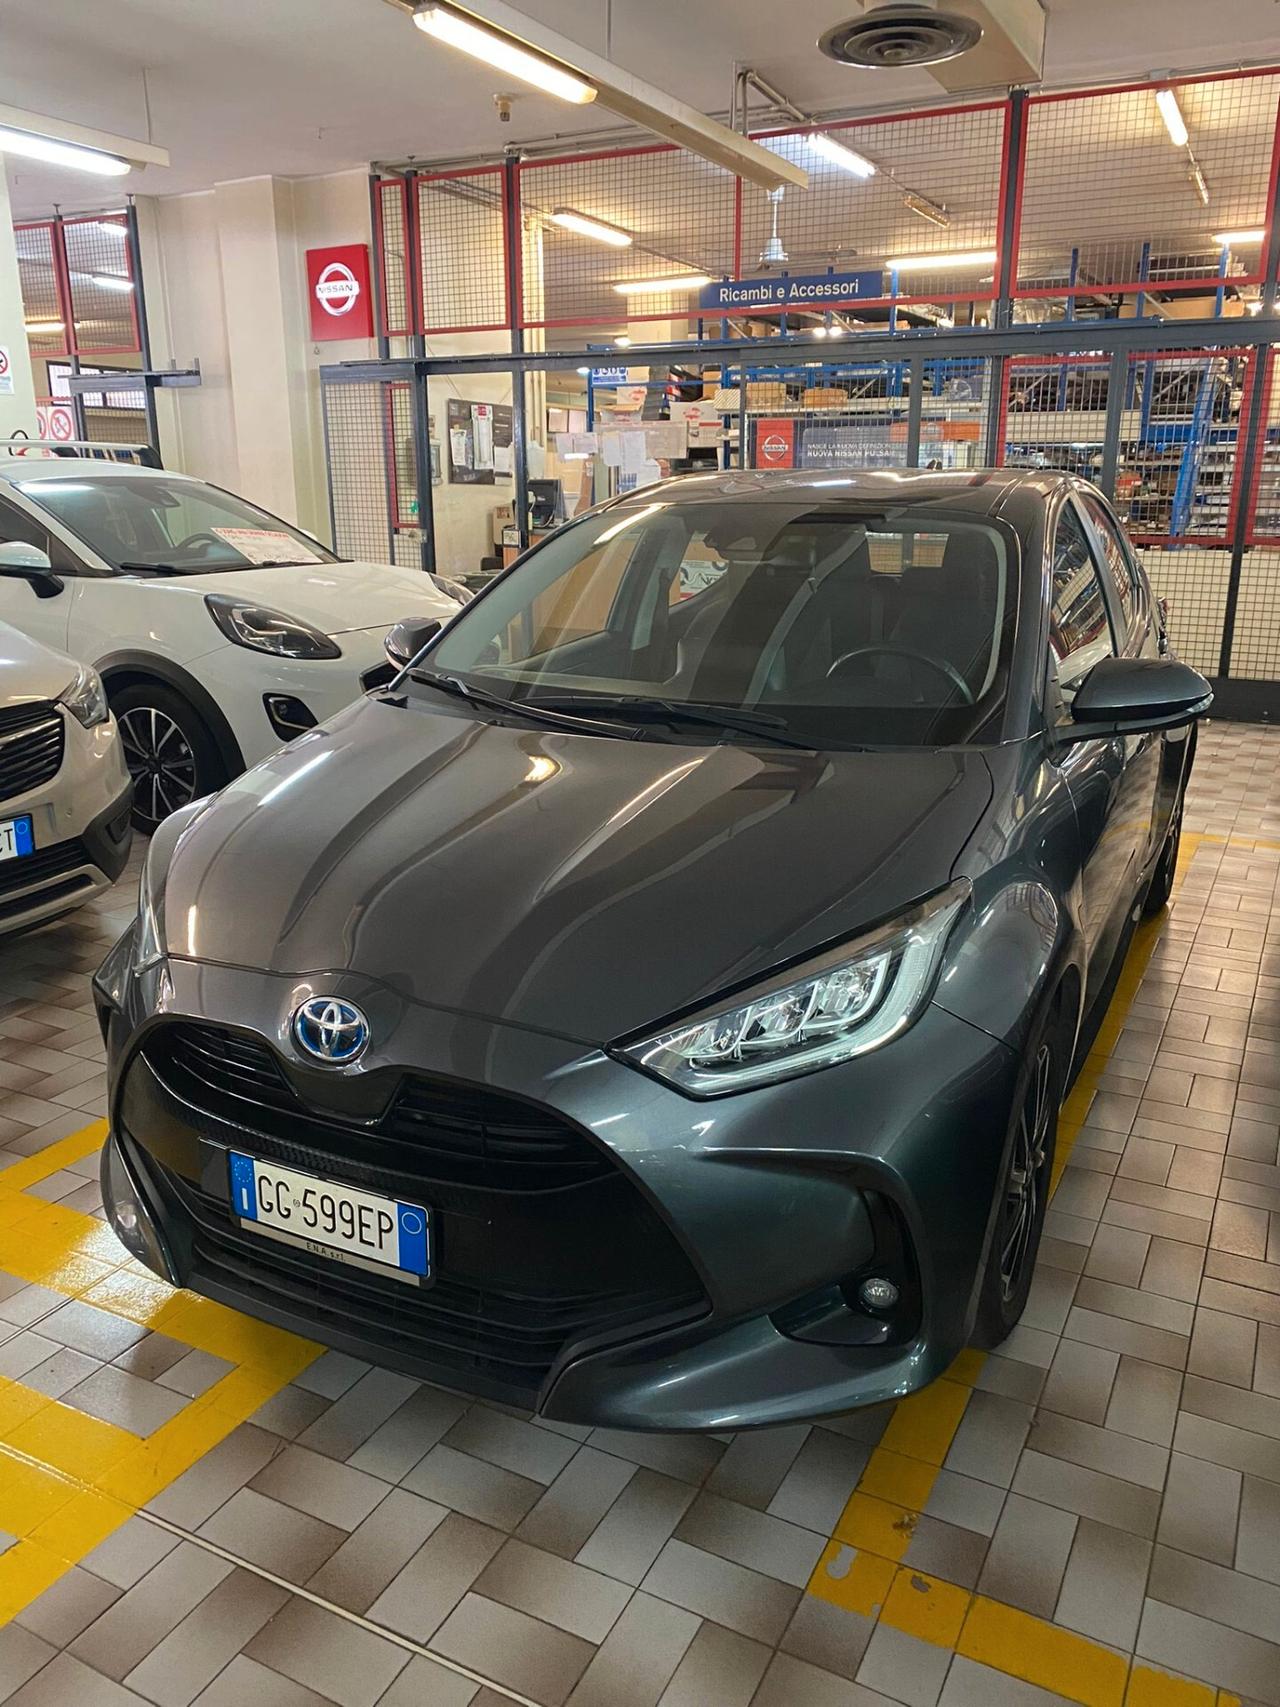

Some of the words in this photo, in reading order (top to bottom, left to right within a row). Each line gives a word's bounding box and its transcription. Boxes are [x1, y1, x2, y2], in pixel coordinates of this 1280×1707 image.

[318, 284, 353, 294] NISSAN
[720, 285, 772, 302] Ricambi
[777, 288, 785, 298] e
[789, 279, 859, 297] Accessori
[807, 449, 833, 457] NUOVA
[835, 449, 862, 457] NISSAN
